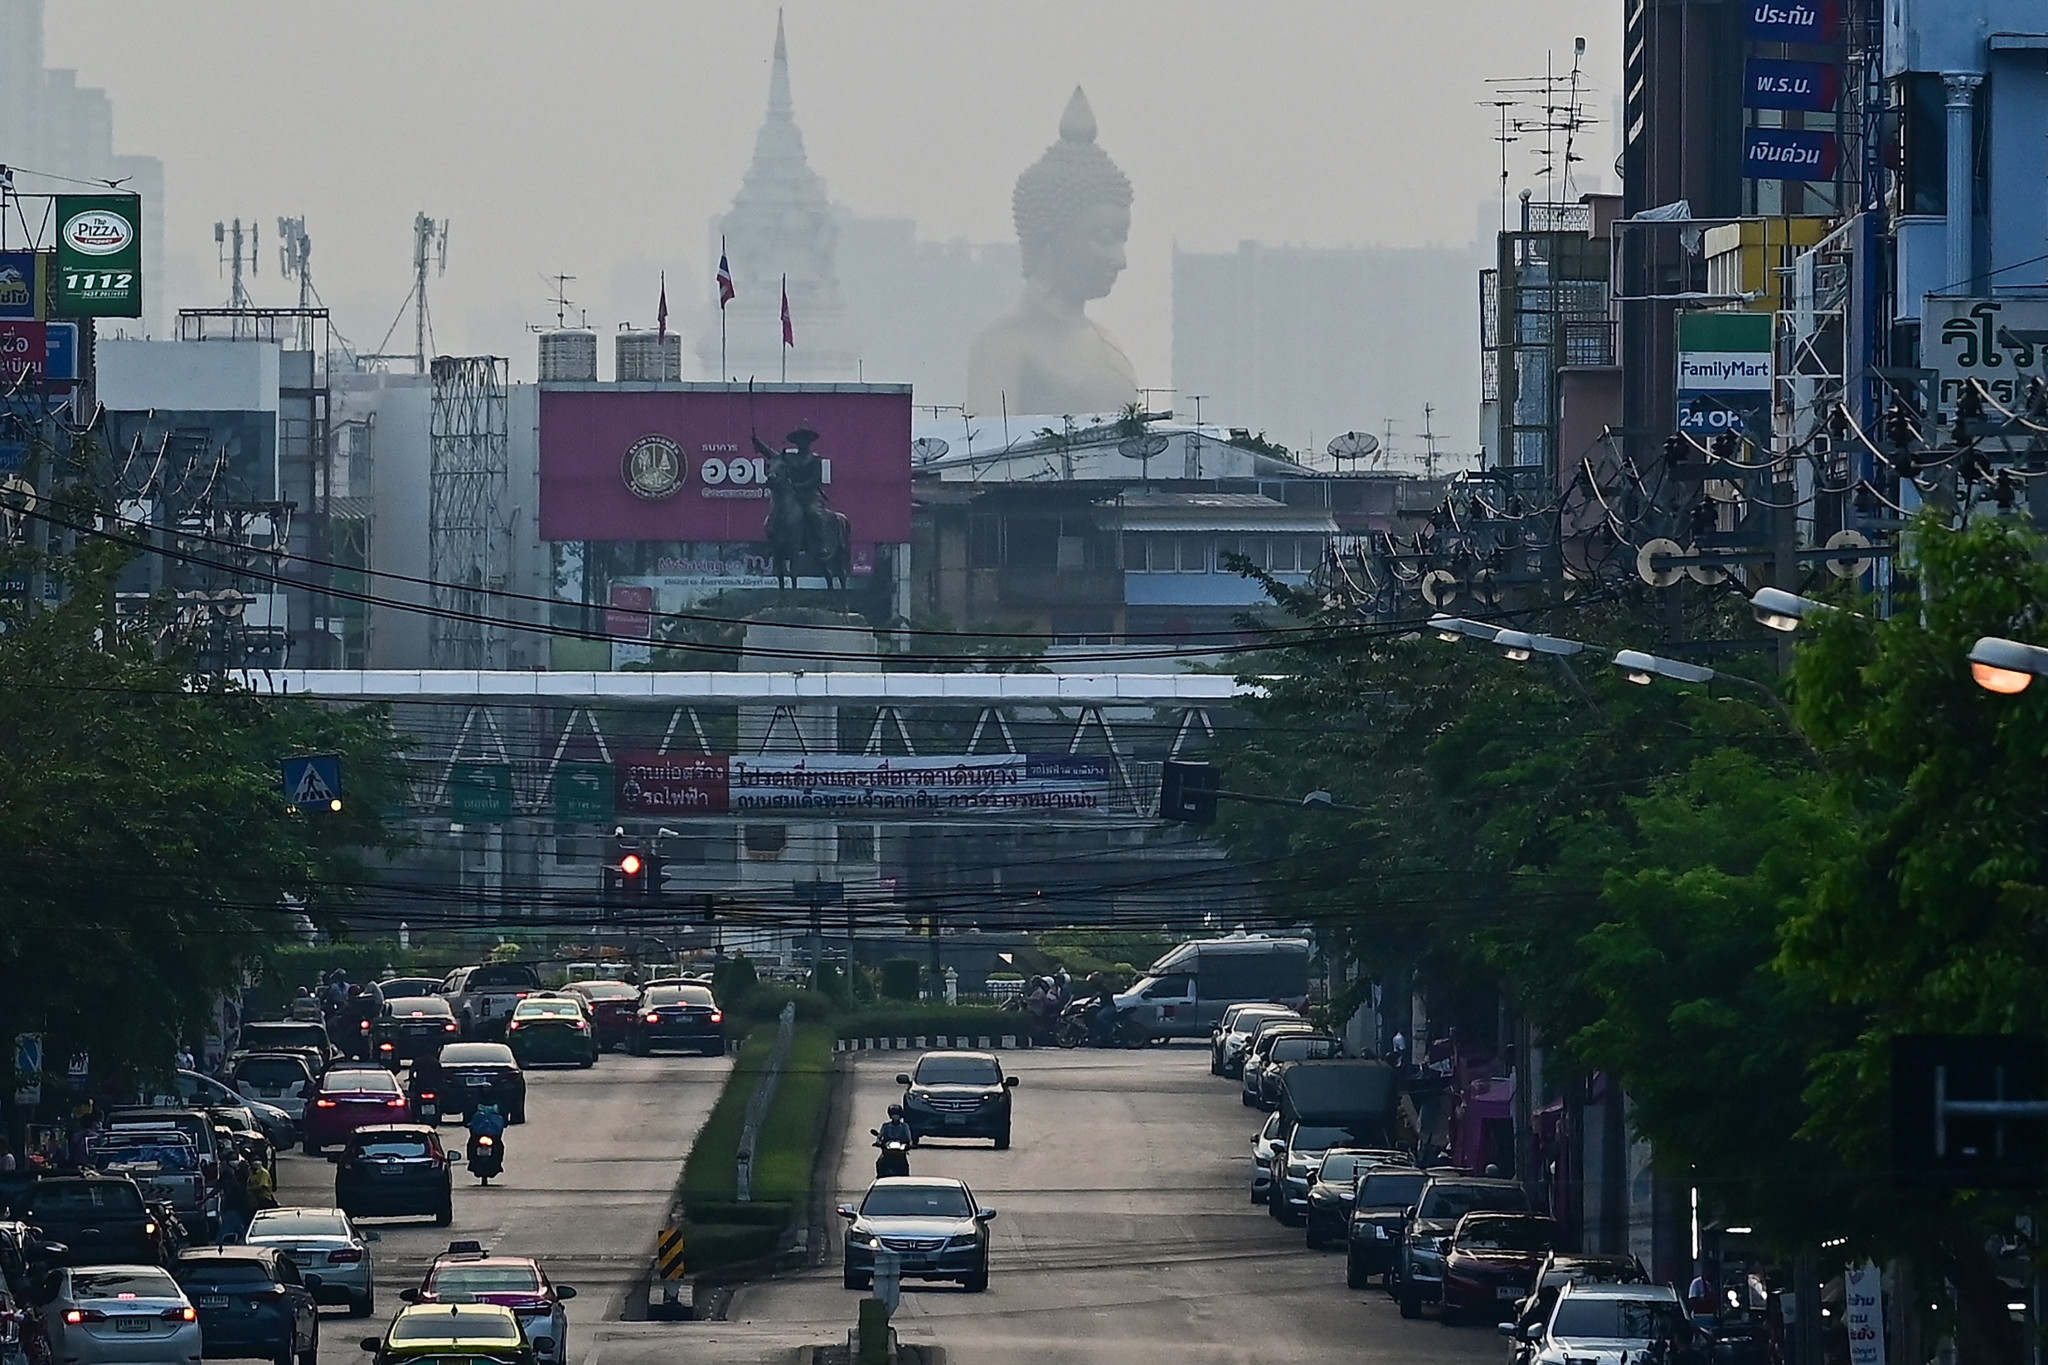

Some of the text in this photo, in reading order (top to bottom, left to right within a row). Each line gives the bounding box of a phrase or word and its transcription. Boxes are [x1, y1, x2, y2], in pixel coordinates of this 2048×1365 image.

[1754, 3, 1816, 27] ประกัน
[1757, 76, 1811, 95] พ.ร.บ.
[1749, 141, 1820, 165] เงินด่วน
[78, 223, 120, 237] PIZZA
[66, 274, 133, 290] 1112
[1681, 361, 1769, 381] FamilyMart
[1680, 408, 1704, 427] 24
[702, 443, 738, 453] ธนาคาร
[629, 760, 725, 781] งานก่อสร้าง
[643, 786, 709, 806] รถไฟฟ้า
